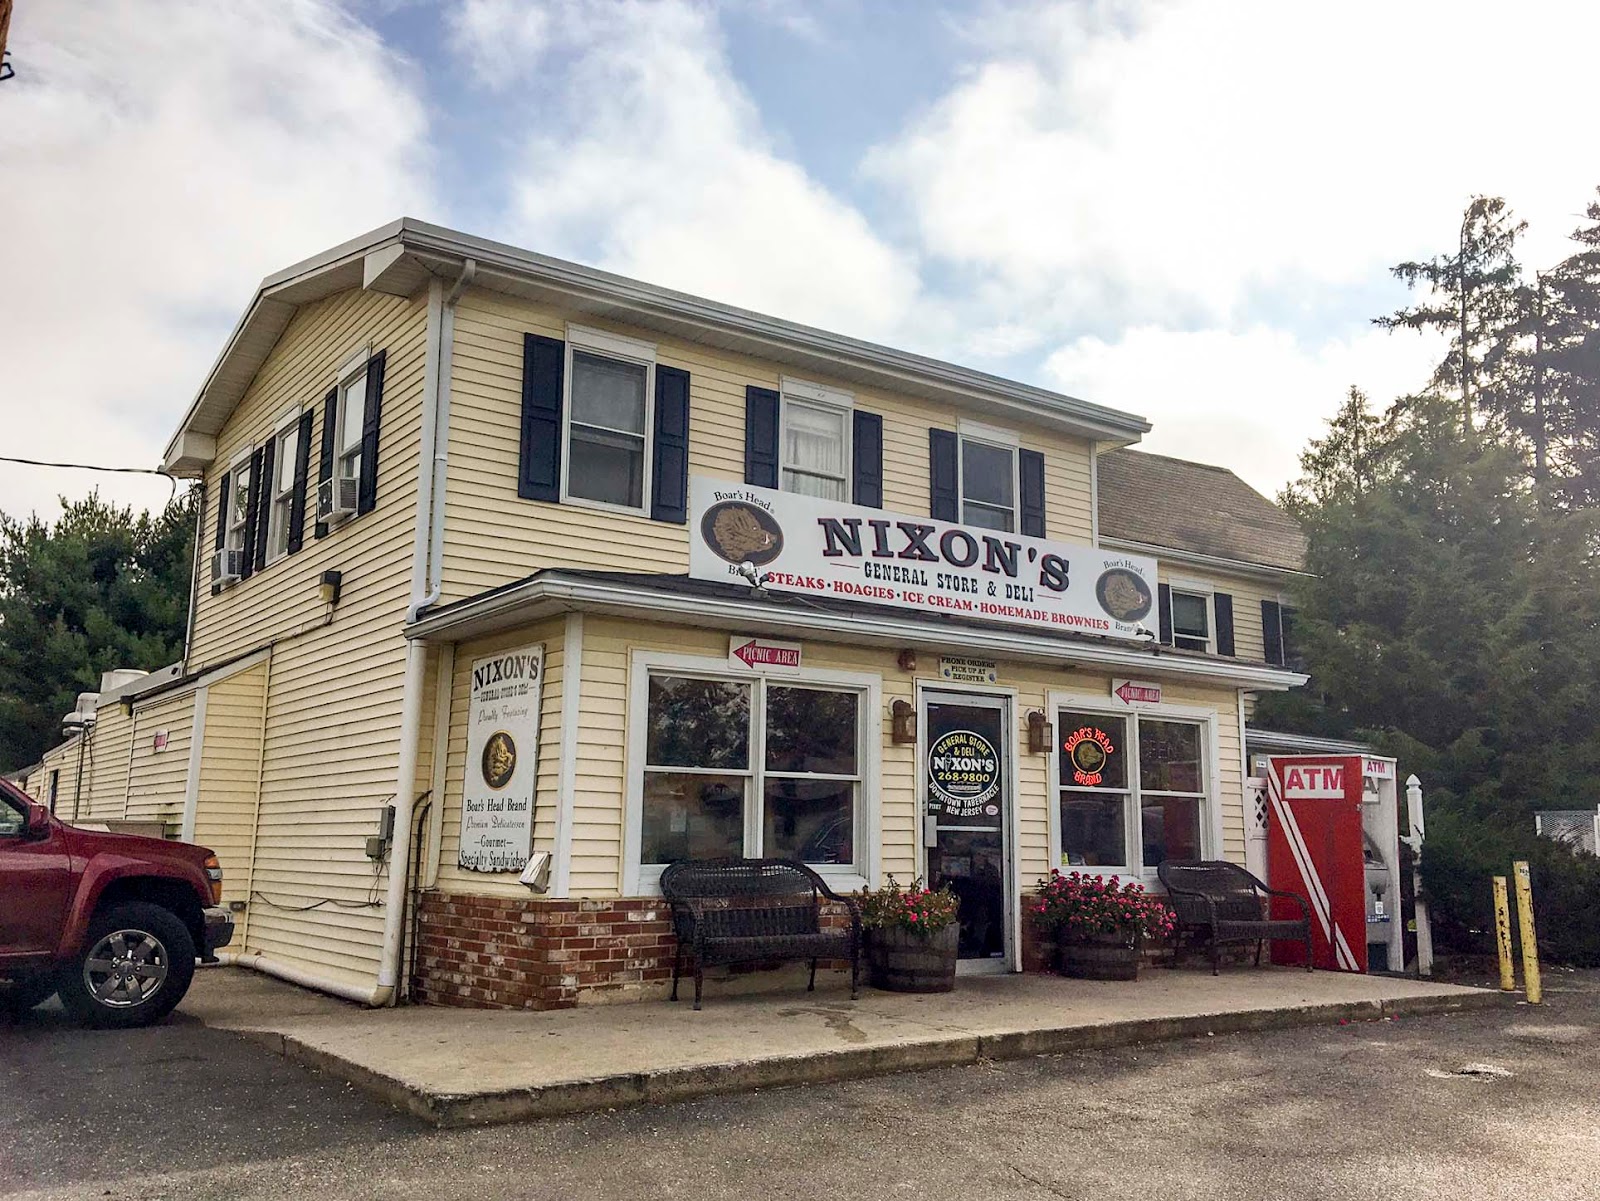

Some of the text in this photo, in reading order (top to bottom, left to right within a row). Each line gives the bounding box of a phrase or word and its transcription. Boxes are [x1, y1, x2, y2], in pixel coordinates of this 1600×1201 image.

[713, 490, 771, 511] Boar's Head
[816, 517, 1070, 593] NIXON'S
[1102, 559, 1143, 575] Boar's Head
[864, 561, 1034, 603] GENERAL STORE & DELI
[767, 571, 1110, 631] STEAKS HOAGIES ICE CREAM HOMEMADE BROWNIES
[742, 646, 798, 665] PICNIC AREA
[941, 656, 996, 669] PHONE ORDERS
[473, 655, 540, 693] NIXON'S
[1120, 686, 1160, 701] PICNIC AREA
[937, 734, 991, 757] GENERAL STORE
[1064, 727, 1114, 754] BOAR'S HEAD
[953, 746, 975, 757] & DELI
[1366, 760, 1386, 774] ATM
[937, 771, 990, 783] 268-9800
[1074, 770, 1102, 786] BRAND
[1285, 767, 1345, 791] ATM
[466, 796, 528, 812] Boar's Head Brand
[928, 781, 1000, 808] DOWNTOWN TABERNACLE
[946, 805, 960, 816] NEW
[960, 805, 983, 817] JERSEY
[480, 834, 507, 848] Gourmet
[460, 849, 528, 870] Specialty Sandwiches
